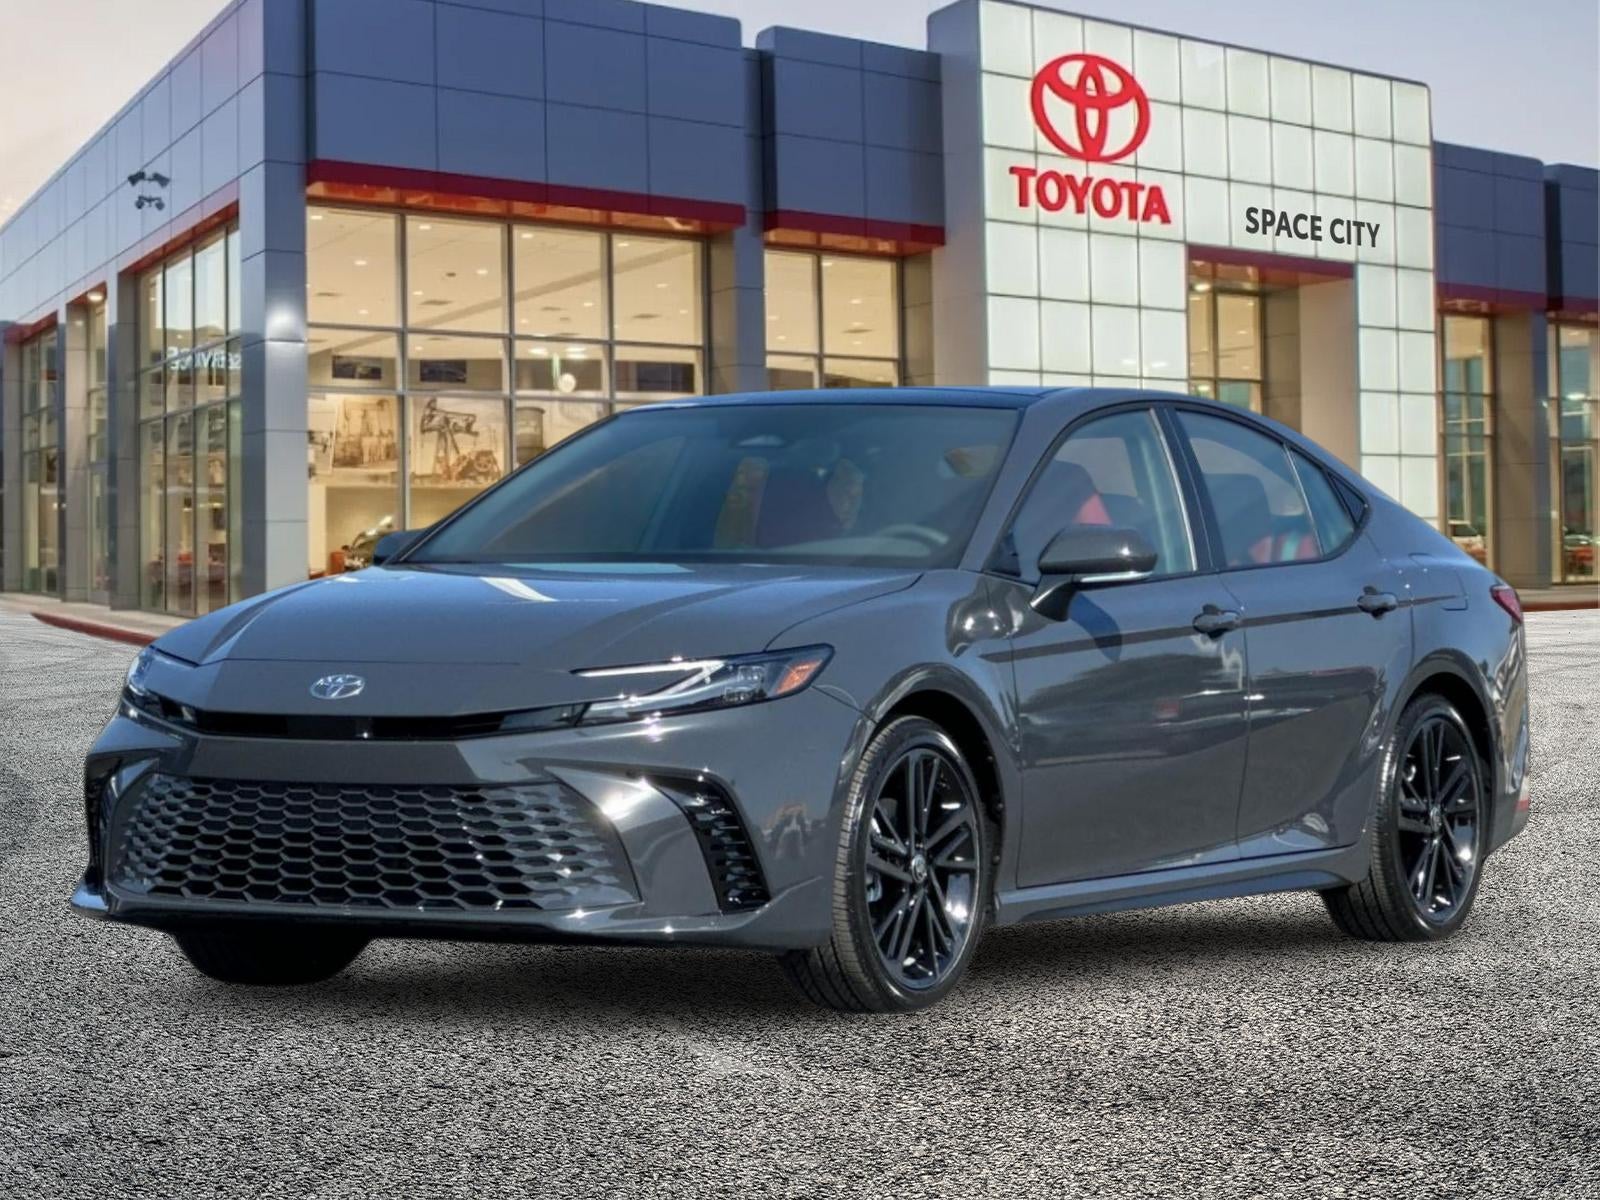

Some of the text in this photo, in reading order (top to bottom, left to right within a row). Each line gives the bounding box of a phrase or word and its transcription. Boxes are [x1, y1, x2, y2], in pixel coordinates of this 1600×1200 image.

[1009, 166, 1171, 224] TOYOTA
[1245, 206, 1381, 248] SPACE CITY
